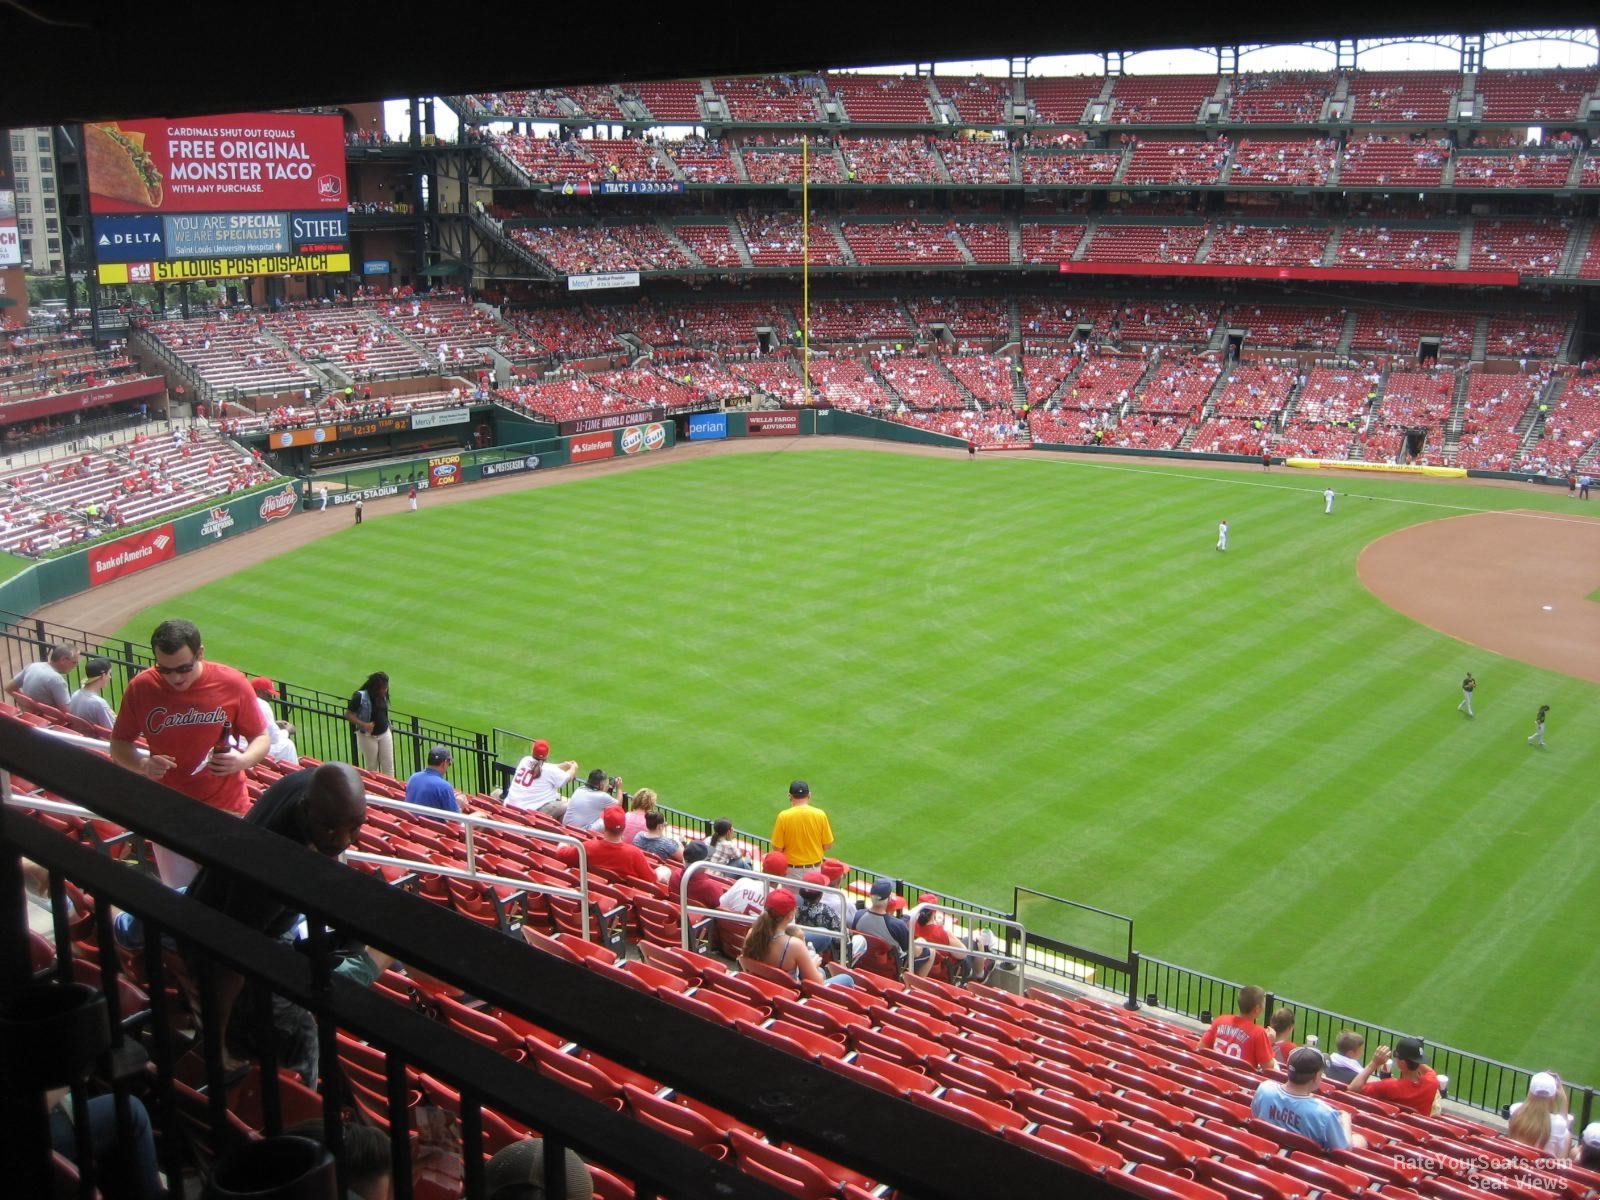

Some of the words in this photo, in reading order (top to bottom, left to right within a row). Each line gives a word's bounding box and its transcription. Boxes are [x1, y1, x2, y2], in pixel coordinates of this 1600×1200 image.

[167, 127, 218, 137] CARDINALS
[220, 128, 242, 137] SHUT
[244, 129, 262, 138] OUT
[263, 129, 296, 139] EQUALS
[168, 140, 216, 159] FREE
[220, 141, 310, 160] ORIGINAL
[170, 162, 262, 180] MONSTER
[171, 184, 195, 193] WITH
[196, 184, 214, 193] ANY
[217, 184, 264, 193] PURCHASE.
[631, 183, 637, 193] A
[173, 217, 198, 230] YOU
[203, 216, 226, 229] ARE
[230, 215, 282, 228] SPECIAL
[293, 218, 347, 238] STIFEL
[114, 233, 161, 244] DELTA
[175, 231, 191, 242] WE
[194, 230, 213, 241] ARE
[215, 228, 281, 241] SPECIALISTS
[175, 246, 194, 254] Saint
[194, 245, 212, 254] Louis
[213, 244, 246, 253] University
[247, 243, 274, 253] Hospital
[158, 262, 179, 278] ST.
[181, 259, 222, 277] LOUIS
[227, 255, 328, 275] POST-DISPATCH
[572, 280, 590, 288] Mercy
[415, 417, 432, 427] Mercy
[601, 415, 625, 428] WORLD
[625, 411, 653, 425] CHAMPS
[353, 424, 377, 435] 12:39
[690, 421, 724, 436] perian
[622, 434, 641, 448] Gulf
[645, 431, 663, 445] Gulf
[429, 455, 460, 467] STLFORD
[495, 460, 525, 473] POSTSEASON
[334, 491, 362, 505] BUSCH
[363, 486, 398, 500] STADIUM
[96, 557, 116, 573] Bank
[115, 553, 124, 566] of
[124, 545, 153, 563] America
[146, 706, 228, 735] Cardinals
[514, 767, 535, 788] 20
[1213, 1036, 1242, 1059] 50
